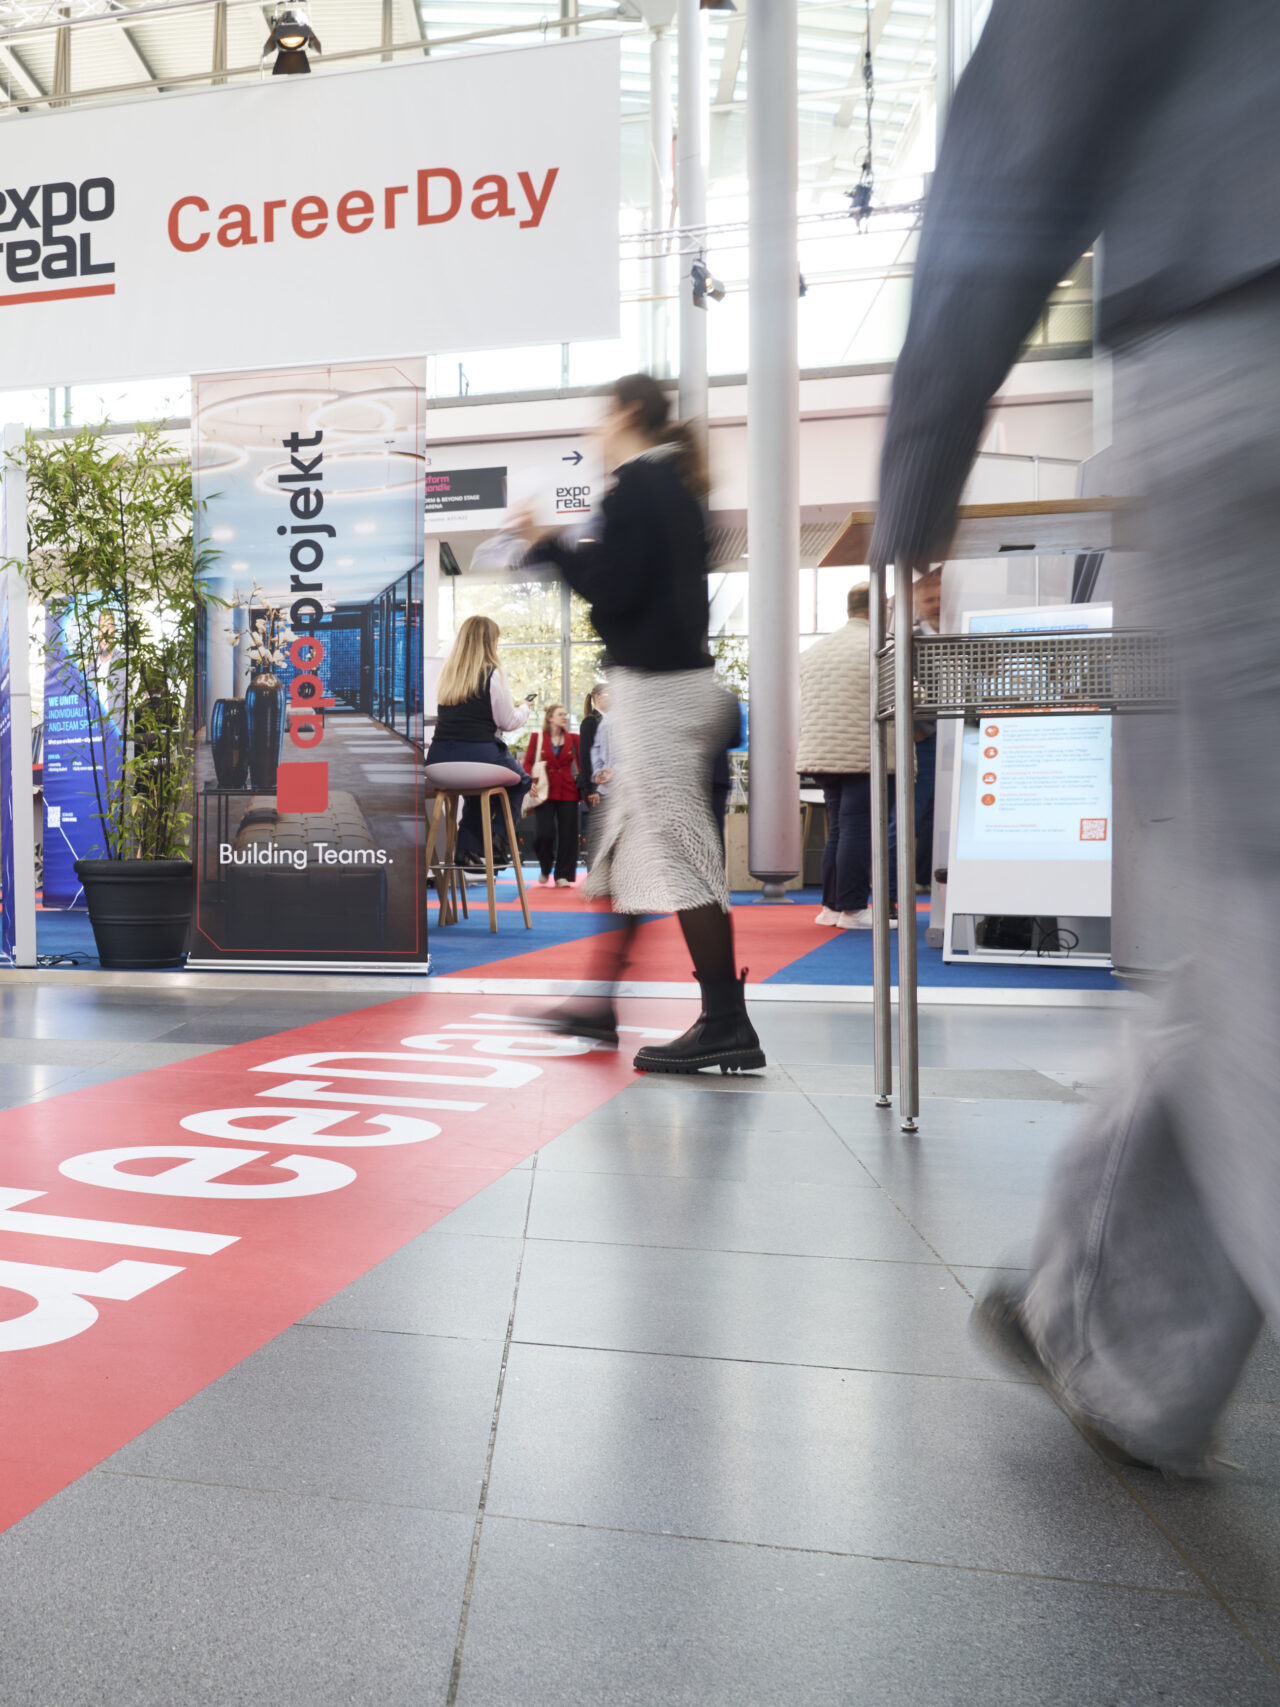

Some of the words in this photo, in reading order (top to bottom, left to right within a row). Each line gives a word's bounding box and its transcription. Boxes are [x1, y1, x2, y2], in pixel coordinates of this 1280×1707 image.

[167, 166, 560, 253] CareerDay
[556, 486, 590, 500] expo
[277, 430, 336, 750] apoprojekt
[48, 696, 59, 707] WE
[59, 694, 79, 706] UNITE
[48, 722, 61, 732] AND
[62, 721, 79, 731] TEAM
[219, 843, 309, 870] Building
[312, 843, 394, 865] Teams.
